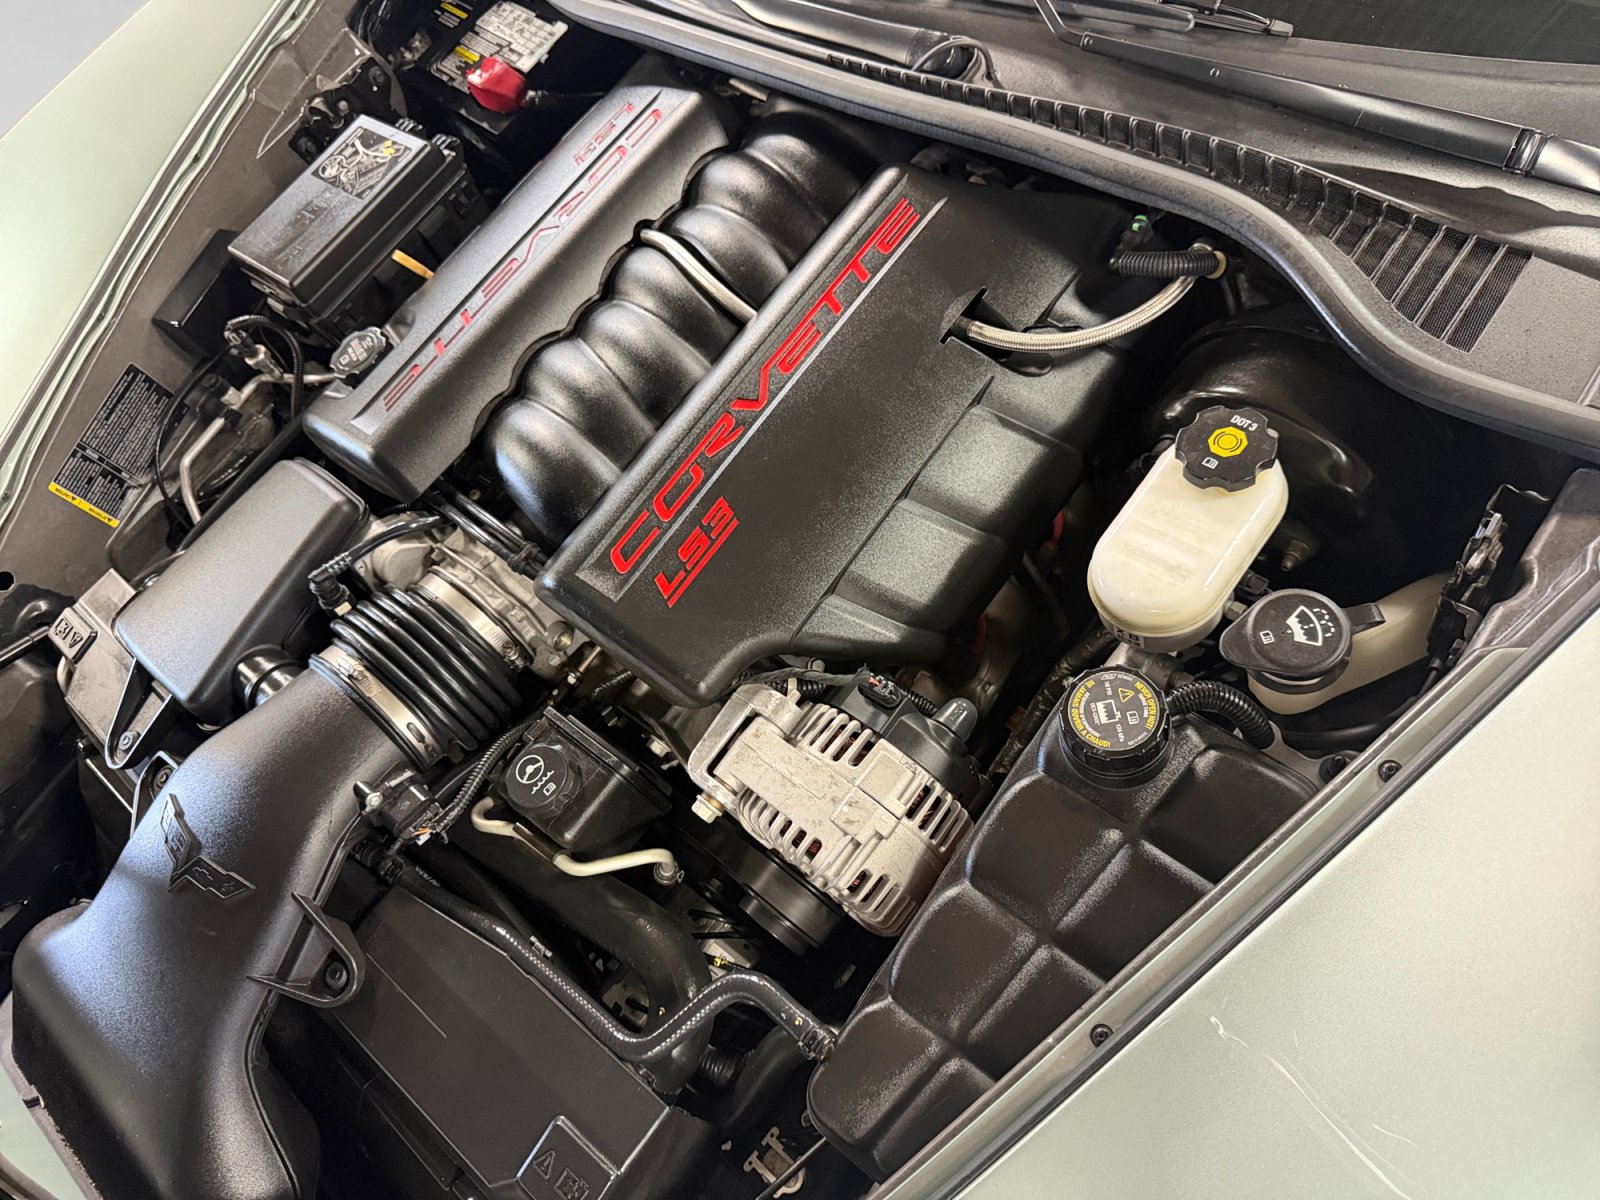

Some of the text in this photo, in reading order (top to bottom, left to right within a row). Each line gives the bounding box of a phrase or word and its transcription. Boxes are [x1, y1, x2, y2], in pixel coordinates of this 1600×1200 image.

[573, 101, 635, 166] LS3
[384, 108, 663, 412] CORVETTE
[610, 197, 920, 574] CORVETTE
[1230, 414, 1259, 431] DOT 3
[653, 495, 736, 602] LS3
[1072, 685, 1087, 707] JAMAIS
[1085, 679, 1095, 689] NE
[1071, 708, 1085, 730] OUVRIR
[1134, 681, 1157, 730] NEVER OPEN HOT!
[1086, 734, 1112, 748] CHAUD!
